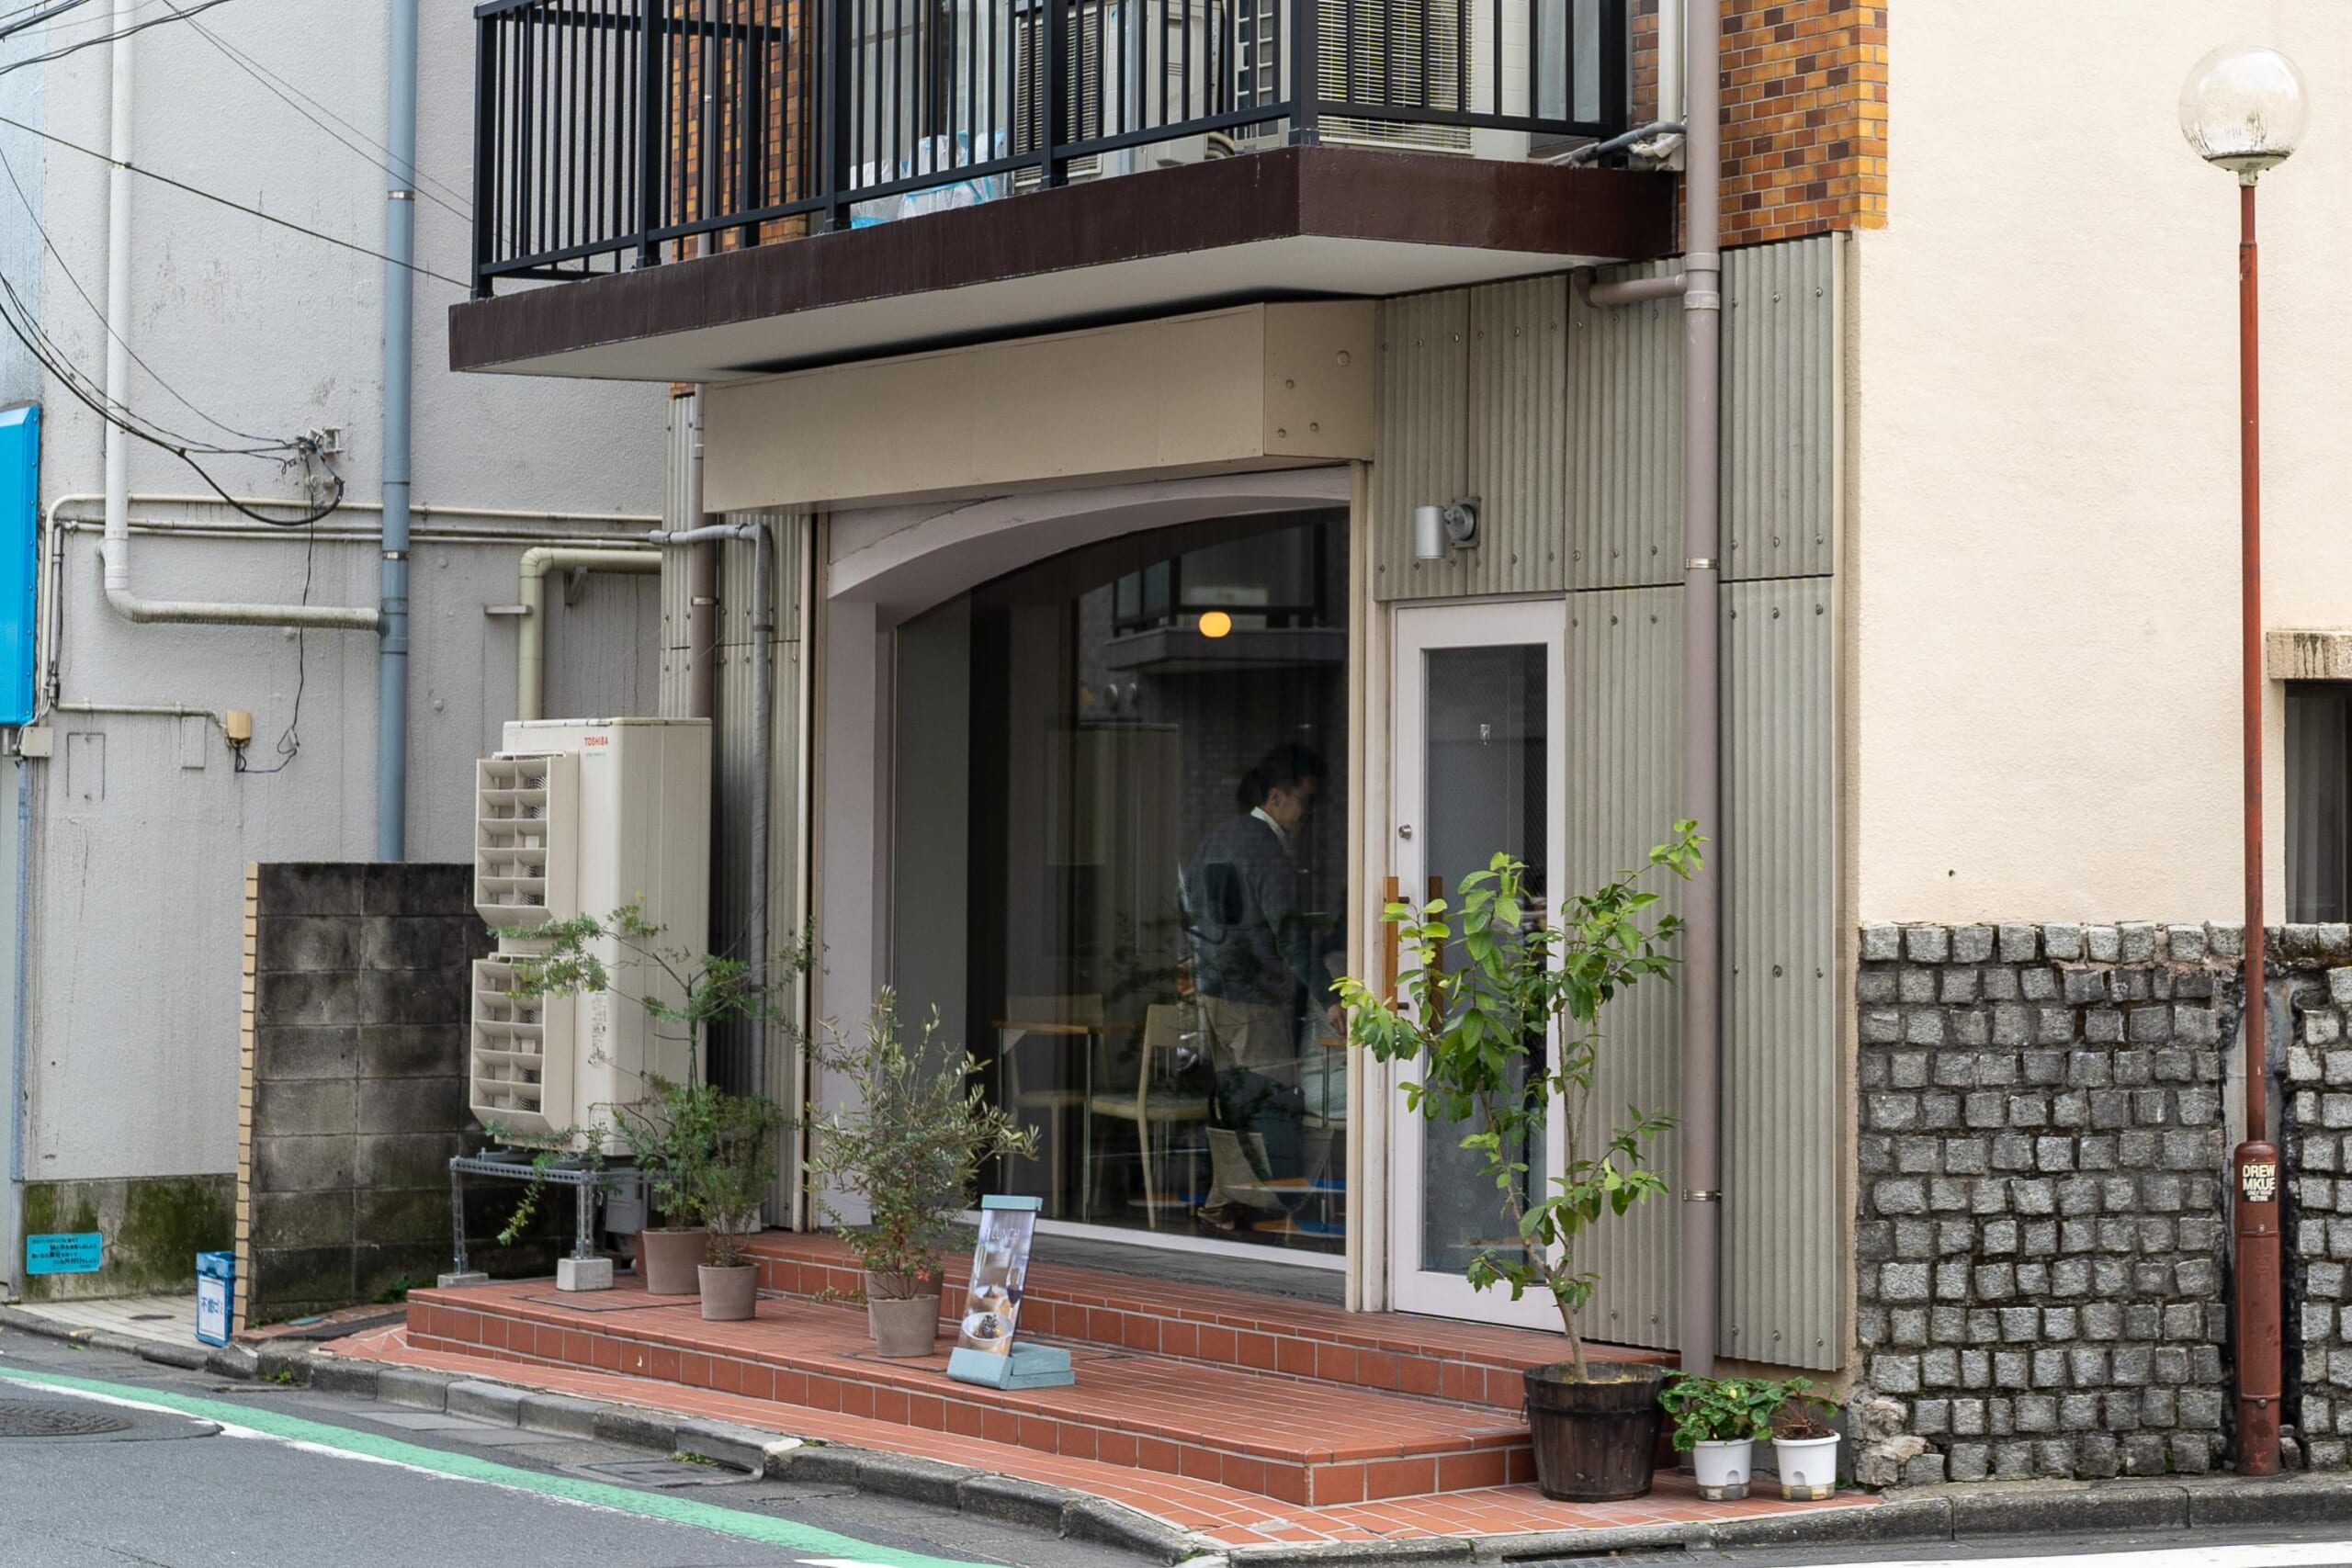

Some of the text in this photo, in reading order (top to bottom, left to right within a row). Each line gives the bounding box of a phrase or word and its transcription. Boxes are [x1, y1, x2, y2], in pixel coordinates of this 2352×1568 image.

[583, 737, 608, 747] TOSHIBA
[2243, 1165, 2276, 1178] DREW
[2243, 1178, 2276, 1190] MKUE
[991, 1228, 1020, 1241] LUNCH
